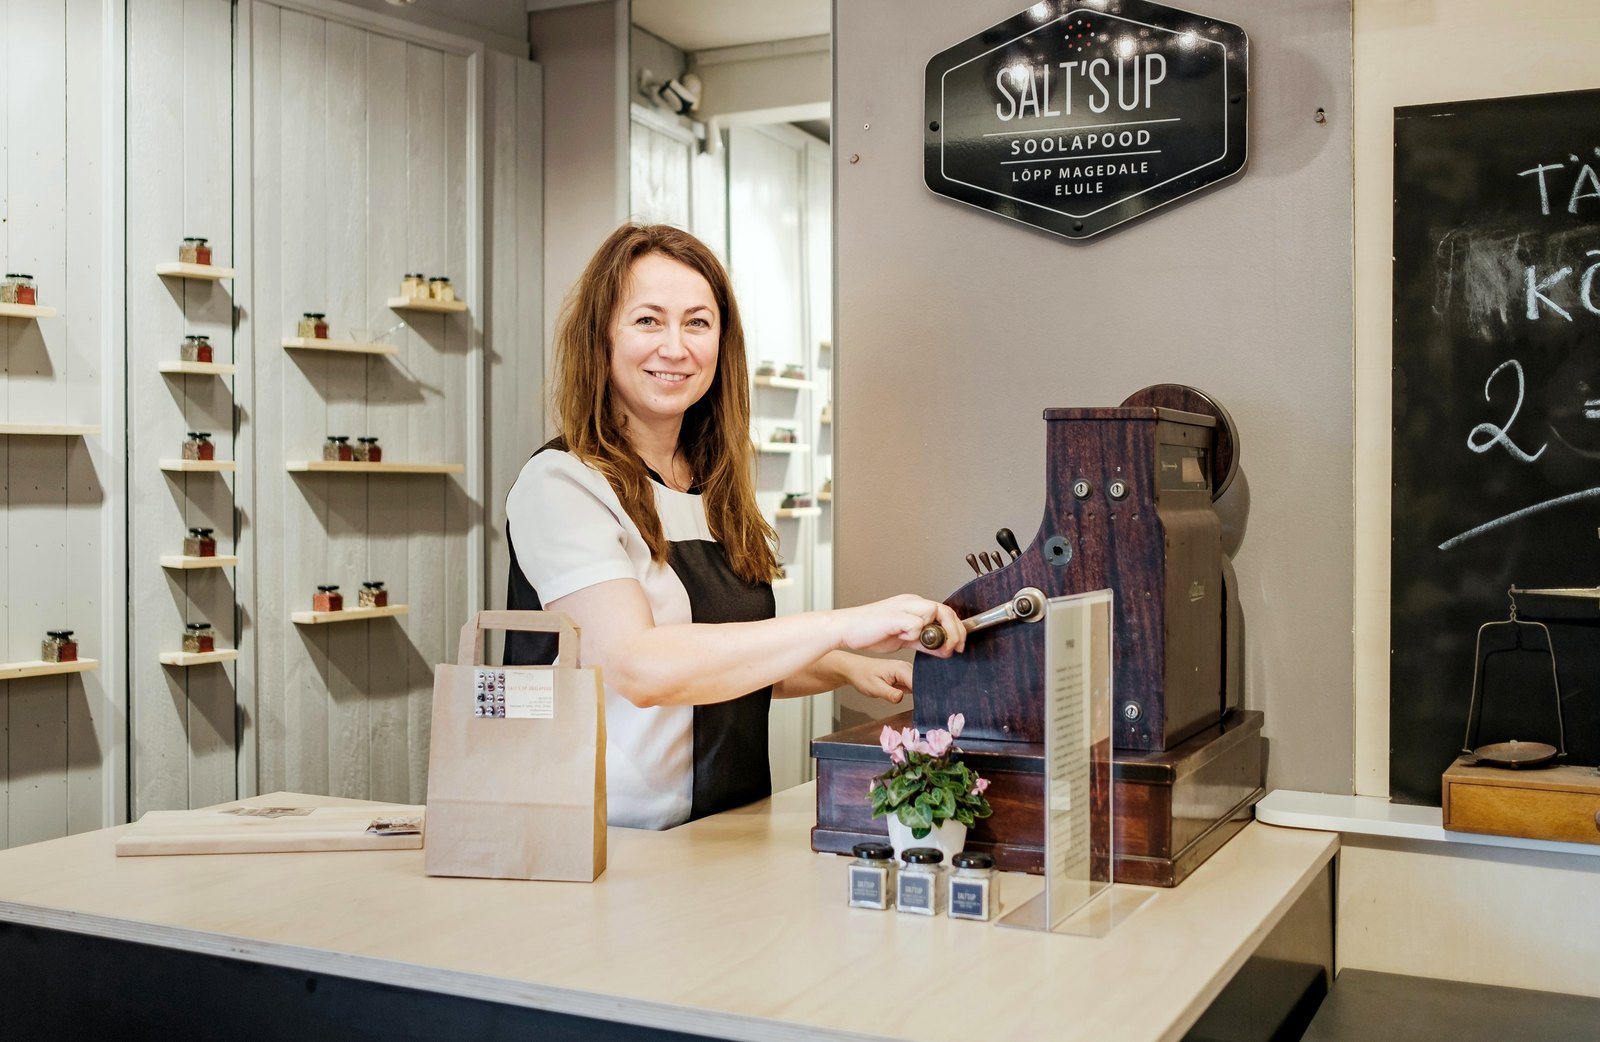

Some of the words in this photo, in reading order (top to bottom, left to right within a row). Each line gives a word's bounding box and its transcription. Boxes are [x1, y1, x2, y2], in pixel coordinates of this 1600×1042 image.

[1011, 129, 1151, 155] SOOLAPOOD
[1012, 167, 1052, 182] LÕPP
[1059, 161, 1148, 180] MAGEDALE
[1054, 182, 1104, 196] ELULE
[1467, 359, 1547, 463] 2
